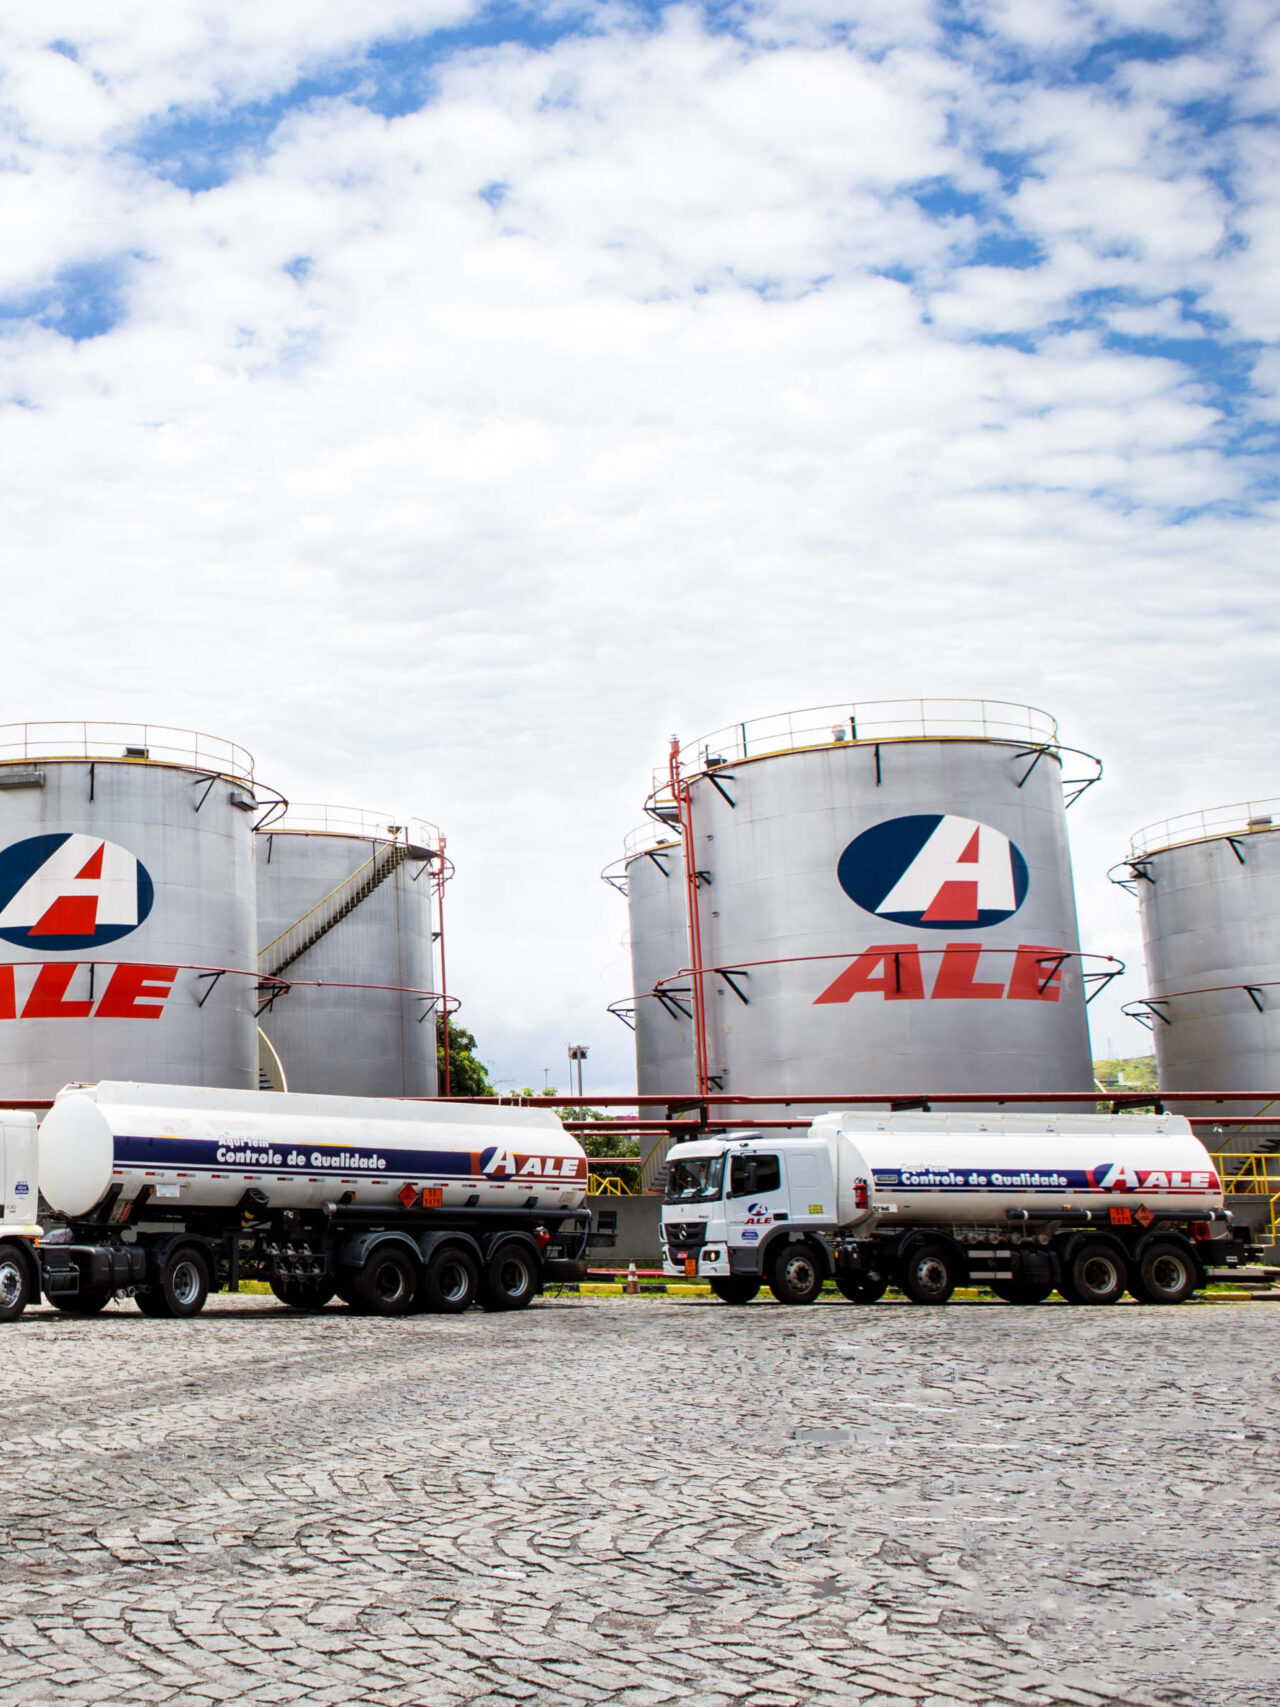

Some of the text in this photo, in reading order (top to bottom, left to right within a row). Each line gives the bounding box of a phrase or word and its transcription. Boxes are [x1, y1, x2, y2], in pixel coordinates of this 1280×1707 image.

[875, 815, 1017, 921] A
[812, 942, 1064, 1005] ALE
[216, 1147, 387, 1169] Controle de Qualidade
[519, 1157, 579, 1177] ALE
[901, 1172, 964, 1185] Controle
[968, 1173, 987, 1185] de
[991, 1173, 1068, 1186] Qualidade
[1142, 1172, 1210, 1188] ALE
[744, 1217, 772, 1225] ALE
